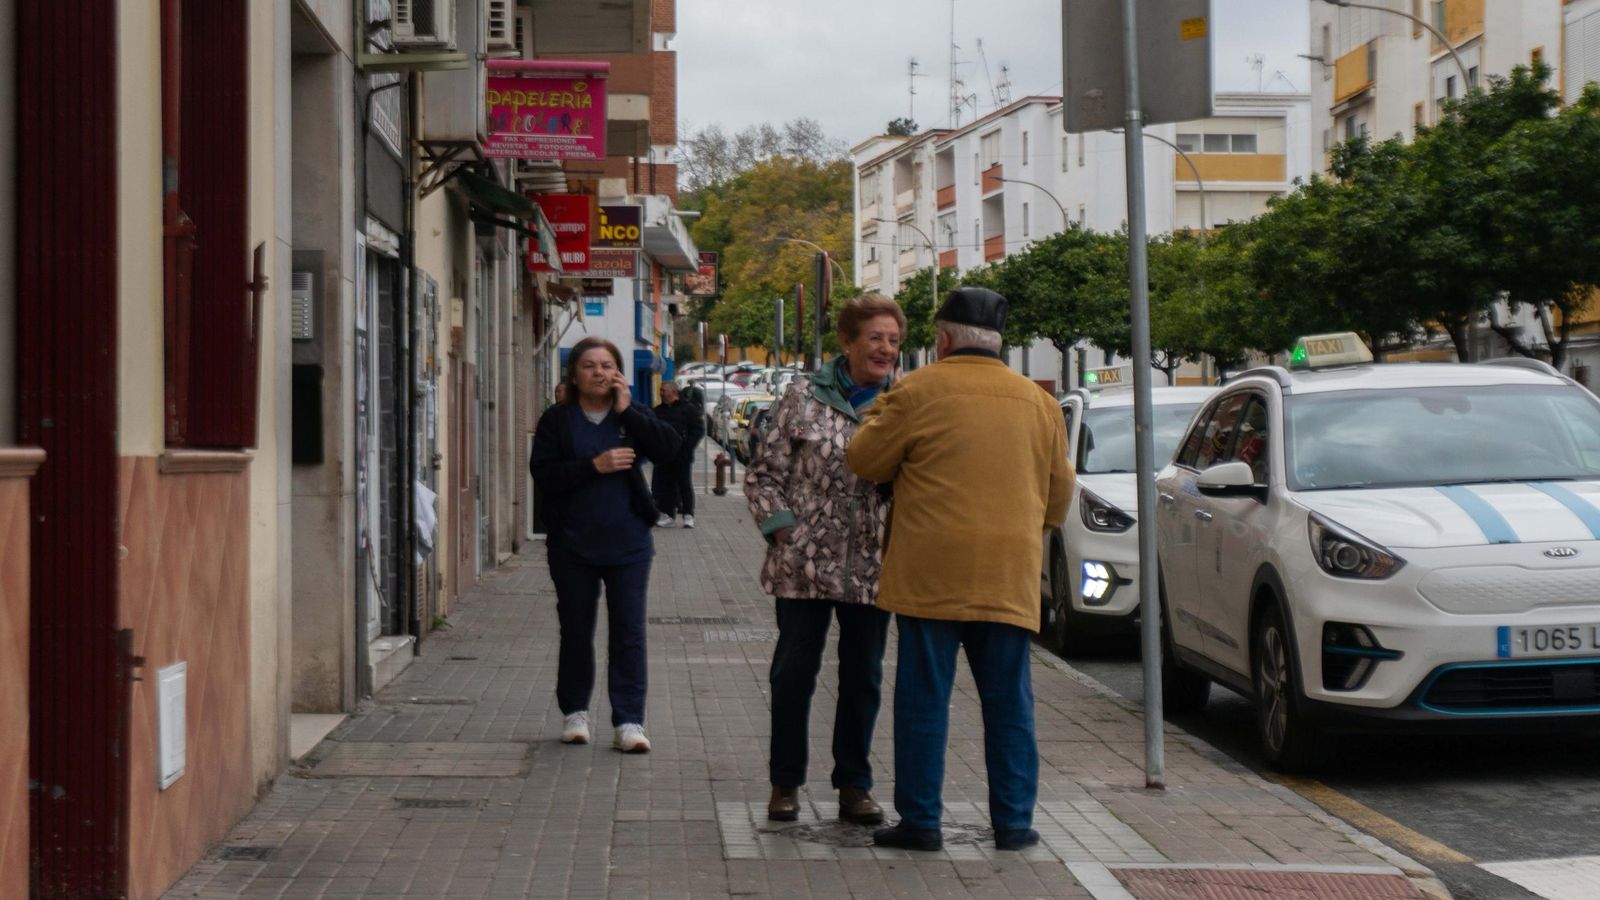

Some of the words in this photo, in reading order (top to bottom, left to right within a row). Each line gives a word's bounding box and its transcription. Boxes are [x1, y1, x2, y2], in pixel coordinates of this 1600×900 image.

[524, 149, 560, 157] ESCOLAR
[539, 143, 588, 151] FOTOCOPIAS
[600, 225, 639, 240] NCO
[533, 252, 547, 264] BA
[561, 251, 586, 264] MURO
[1308, 339, 1342, 354] TAXI
[1099, 369, 1120, 383] TAXI
[1549, 547, 1576, 556] KIA
[1520, 627, 1582, 652] 1065
[1592, 626, 1600, 649] L
